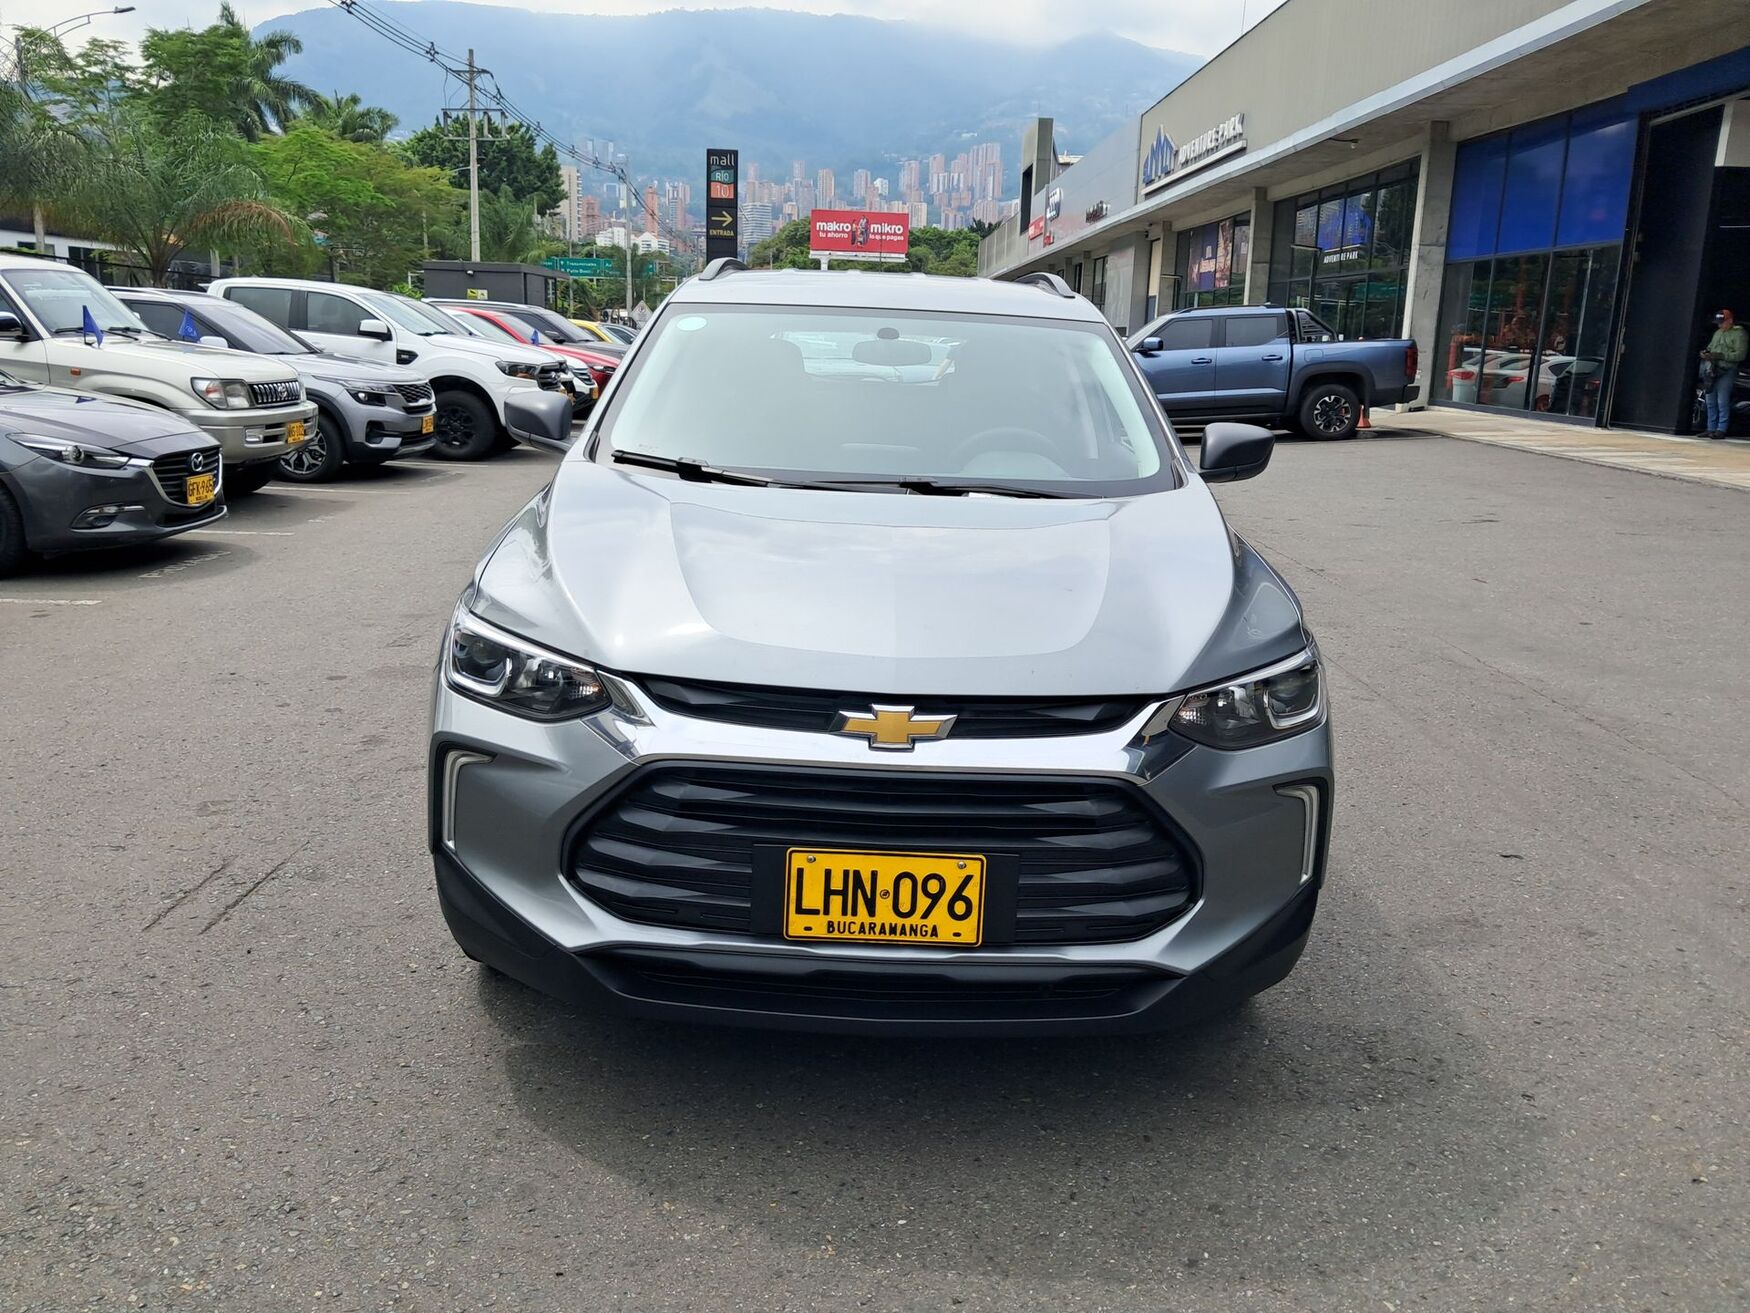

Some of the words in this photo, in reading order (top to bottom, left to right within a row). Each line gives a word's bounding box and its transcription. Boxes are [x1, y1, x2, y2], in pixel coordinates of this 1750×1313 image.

[1219, 113, 1244, 142] PARK
[710, 153, 735, 166] mall
[716, 185, 730, 198] 10
[816, 221, 851, 232] makro
[870, 222, 904, 234] mikro
[709, 229, 735, 237] ENTRADA
[827, 231, 849, 239] ahorro
[1346, 250, 1358, 259] PARK
[826, 920, 939, 938] BUCARAMANGA
